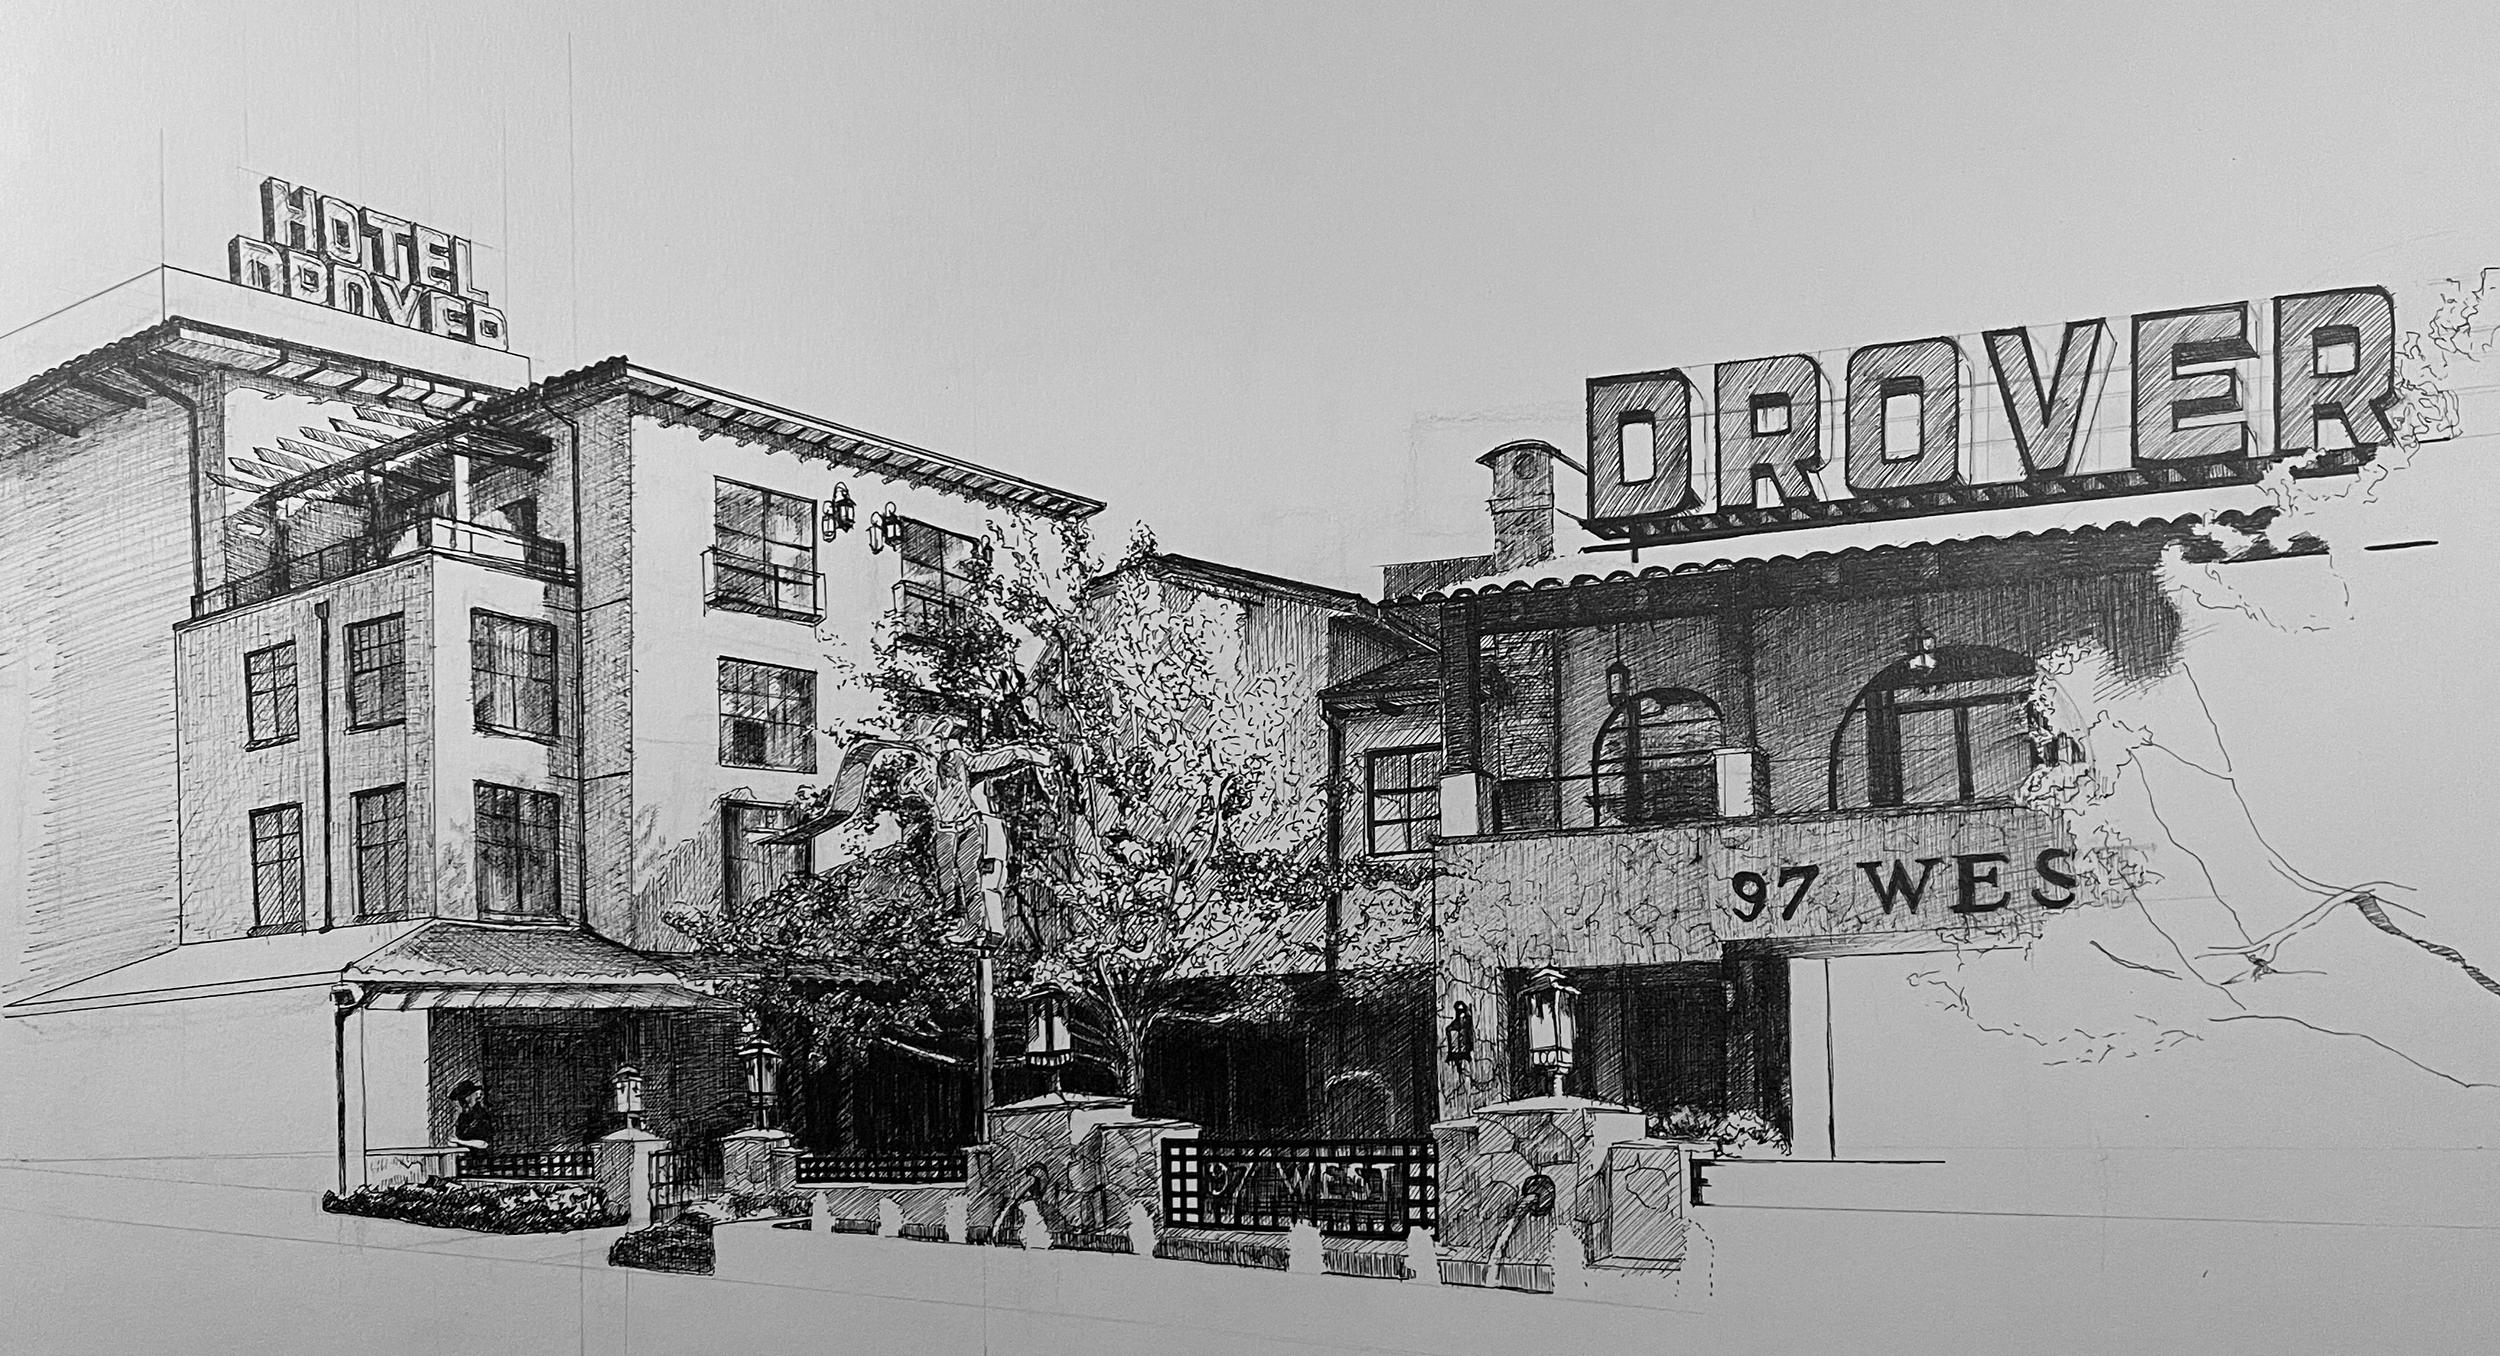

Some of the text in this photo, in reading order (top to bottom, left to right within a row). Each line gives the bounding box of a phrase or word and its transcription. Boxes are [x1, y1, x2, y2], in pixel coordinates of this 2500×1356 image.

[260, 177, 489, 304] HOTEL
[1586, 286, 2397, 520] DROVER
[1732, 865, 1820, 923] 97
[1207, 1161, 1396, 1201] 97 WEST
